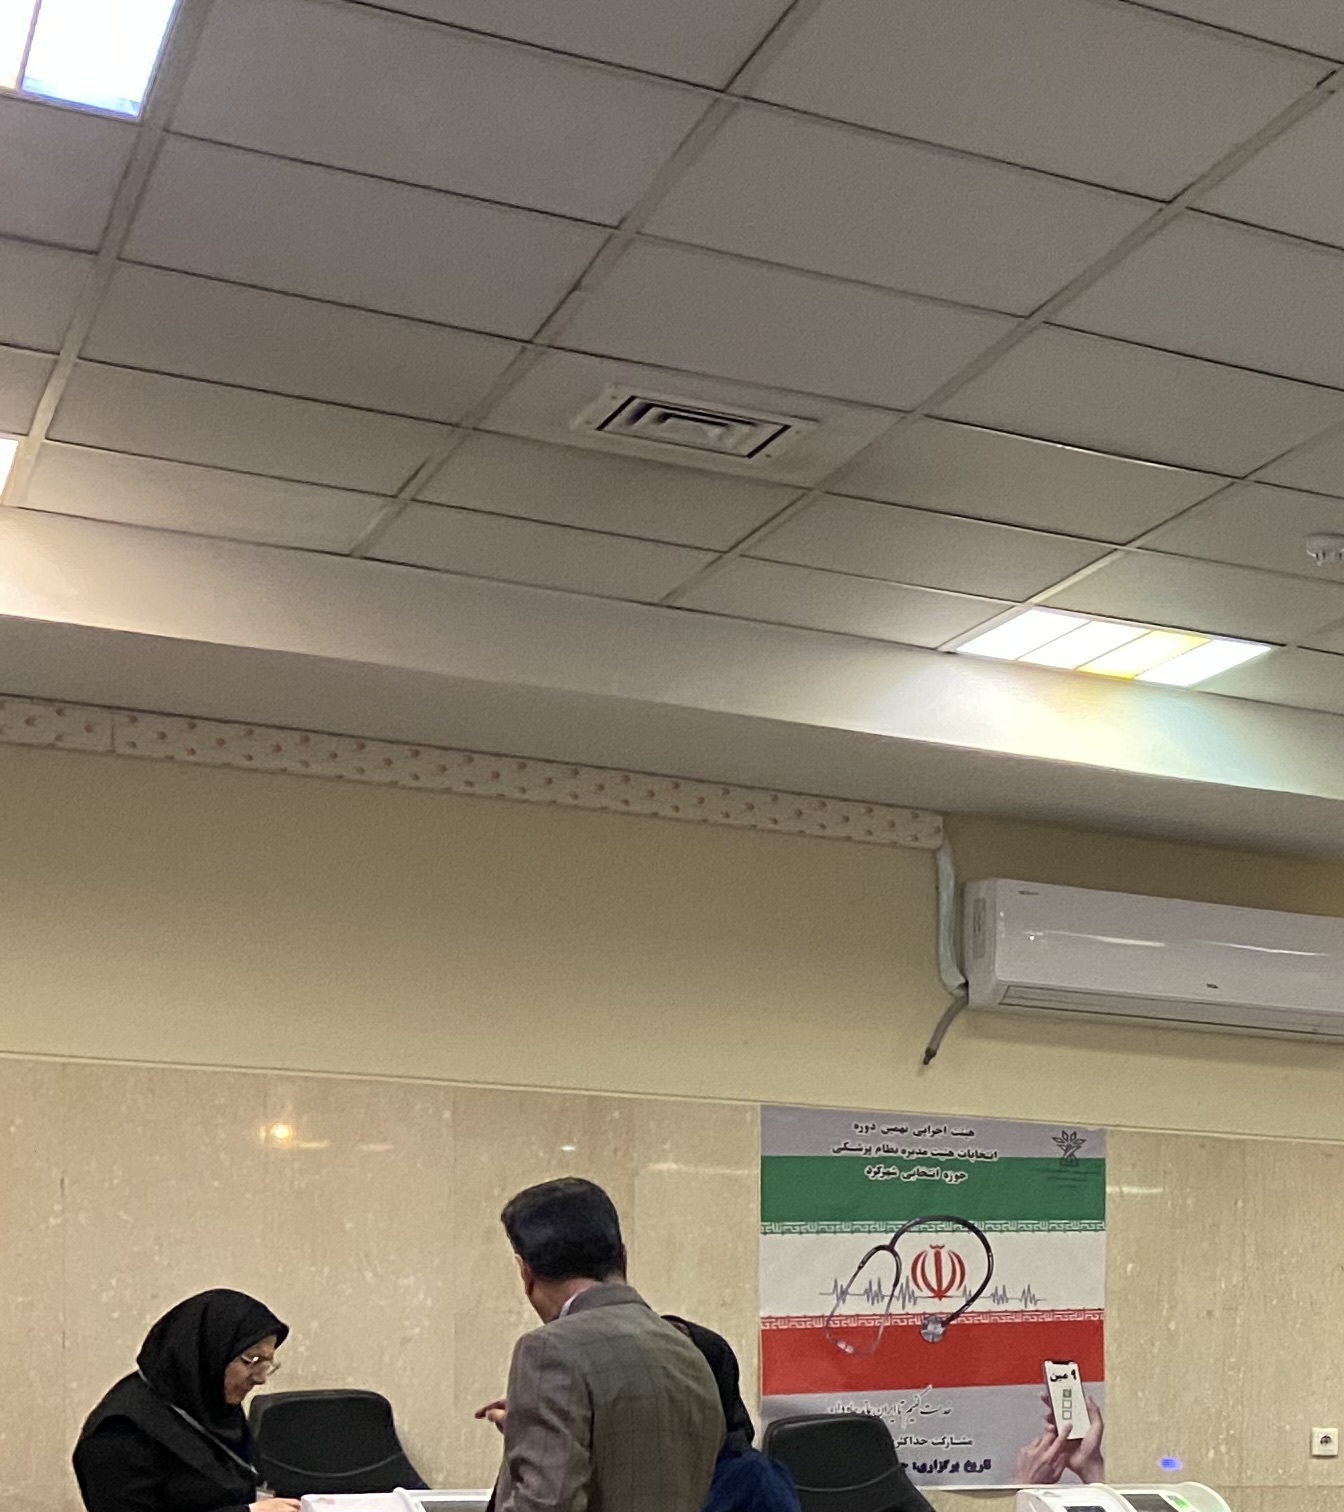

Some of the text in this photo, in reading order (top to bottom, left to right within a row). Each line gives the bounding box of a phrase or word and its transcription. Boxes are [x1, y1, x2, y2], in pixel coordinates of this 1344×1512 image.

[853, 1122, 876, 1134] دوره
[832, 1141, 872, 1156] پزشکی
[875, 1143, 899, 1155] نظام
[957, 1148, 998, 1162] انتخابات
[943, 1169, 967, 1182] حوزه
[896, 1435, 973, 1449] مشارکت حداکثر
[964, 1458, 992, 1474] تاریخ
